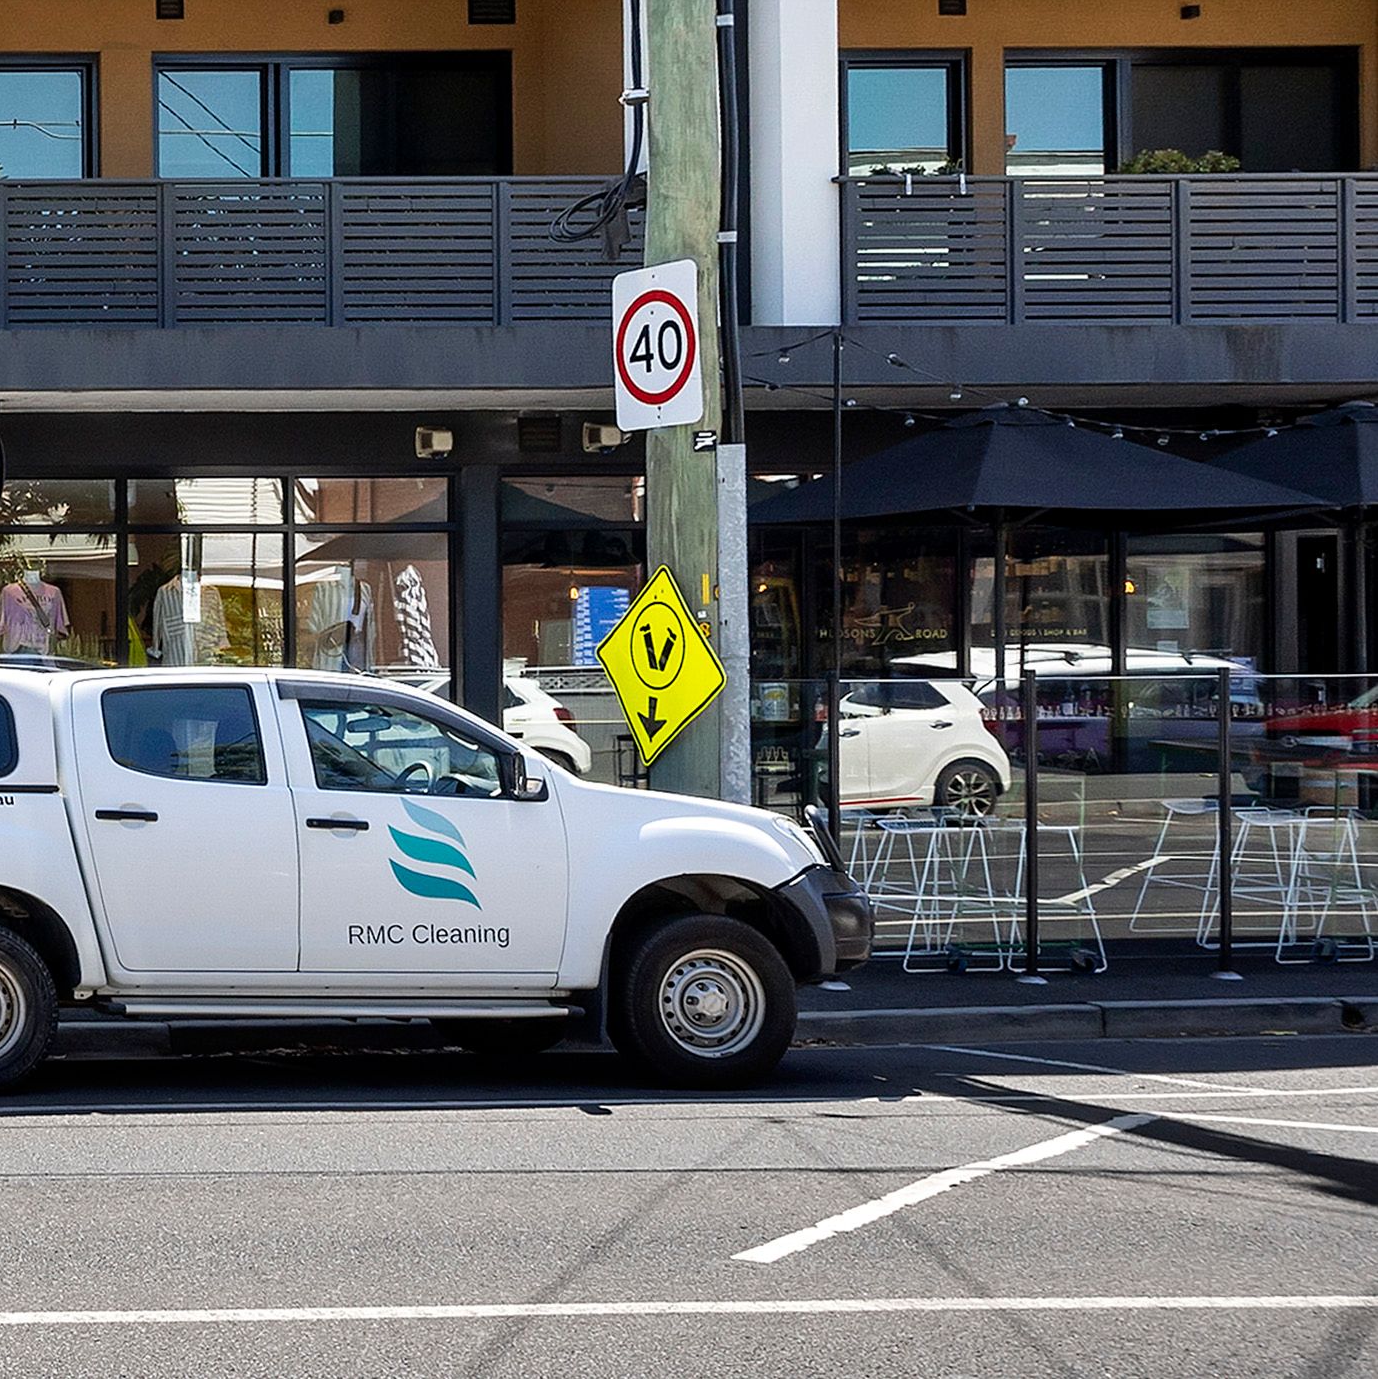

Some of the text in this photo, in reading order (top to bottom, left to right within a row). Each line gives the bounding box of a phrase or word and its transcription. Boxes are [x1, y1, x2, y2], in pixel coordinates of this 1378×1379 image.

[629, 320, 683, 373] 40
[916, 629, 948, 639] ROAD
[348, 924, 510, 948] RMC Cleaning
